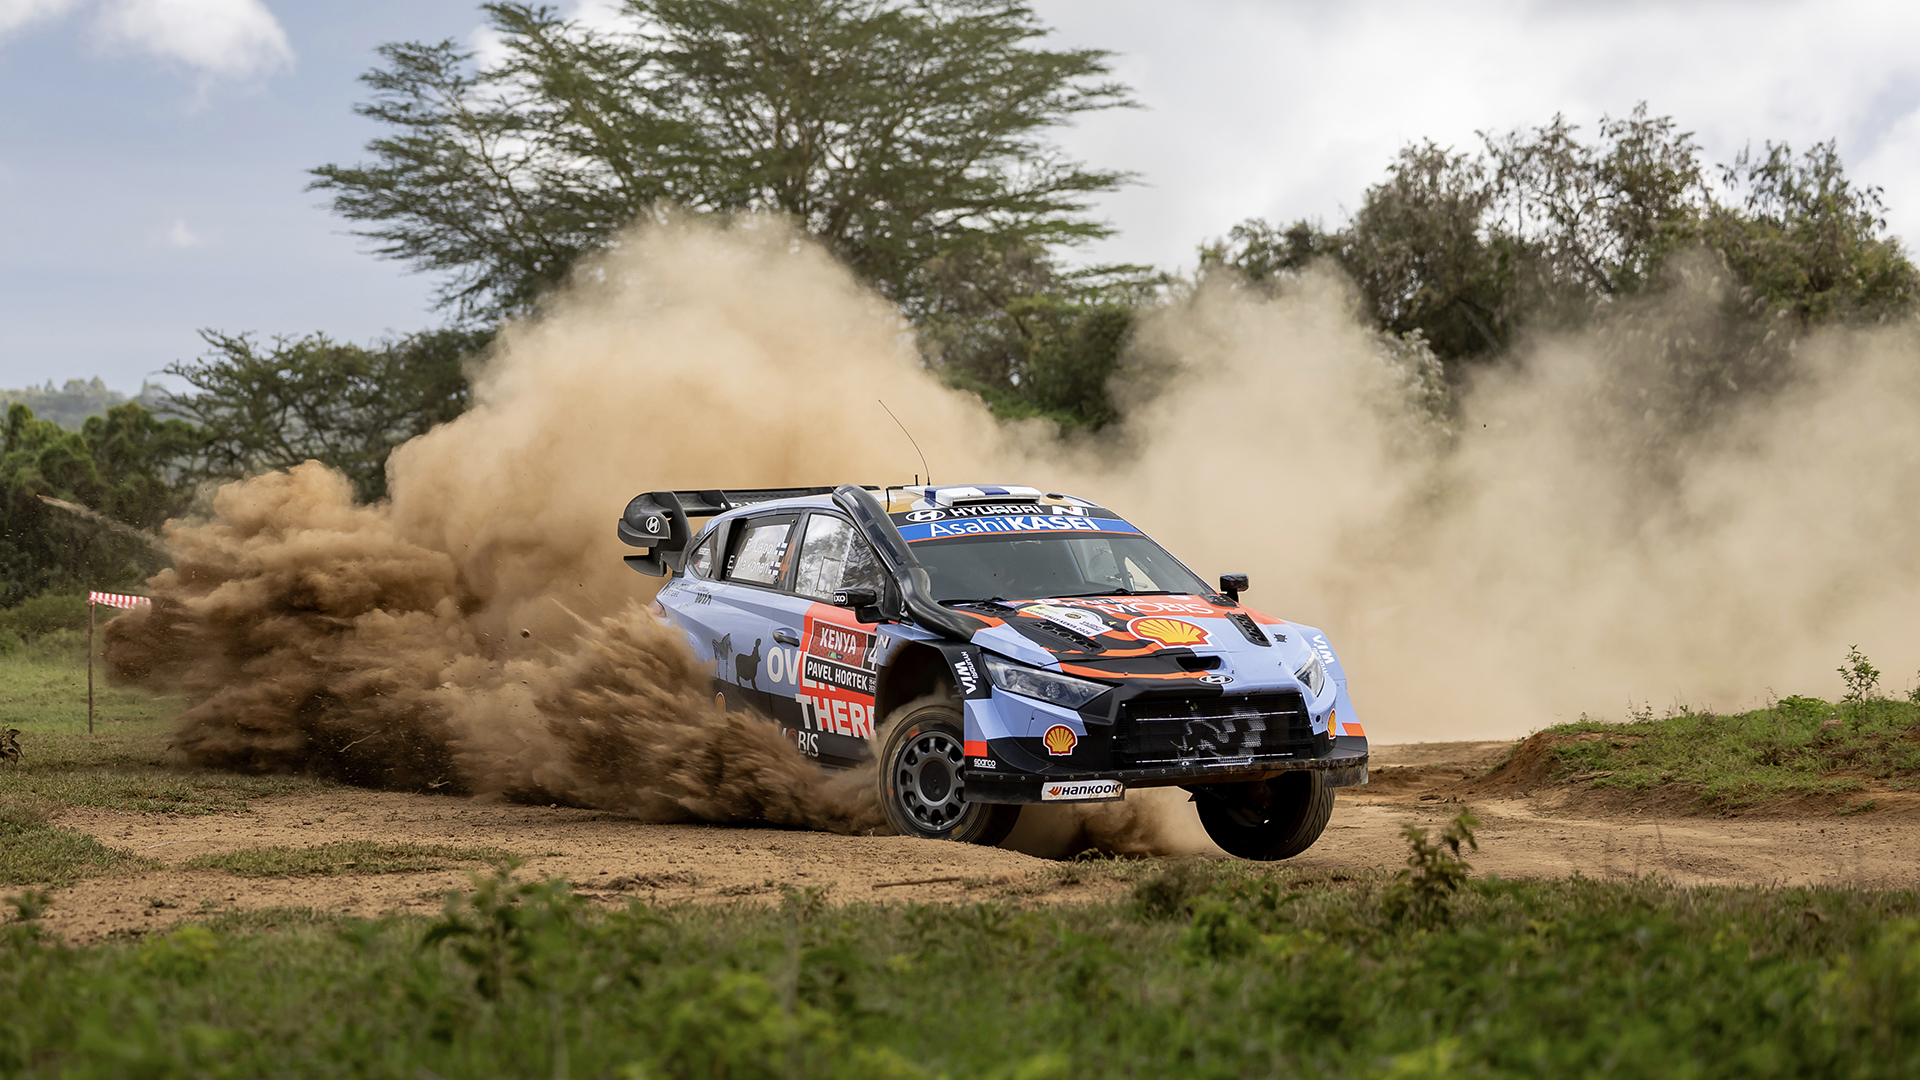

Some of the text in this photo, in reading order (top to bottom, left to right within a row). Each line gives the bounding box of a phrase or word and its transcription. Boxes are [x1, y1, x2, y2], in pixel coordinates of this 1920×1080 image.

[949, 505, 1043, 518] HYUNDAI
[930, 516, 1101, 537] AsahiKASEI
[1097, 602, 1214, 615] MOBIS
[819, 627, 857, 655] KENYA
[867, 636, 877, 671] 4
[807, 660, 833, 682] PAVEL
[835, 668, 868, 691] HORTEK
